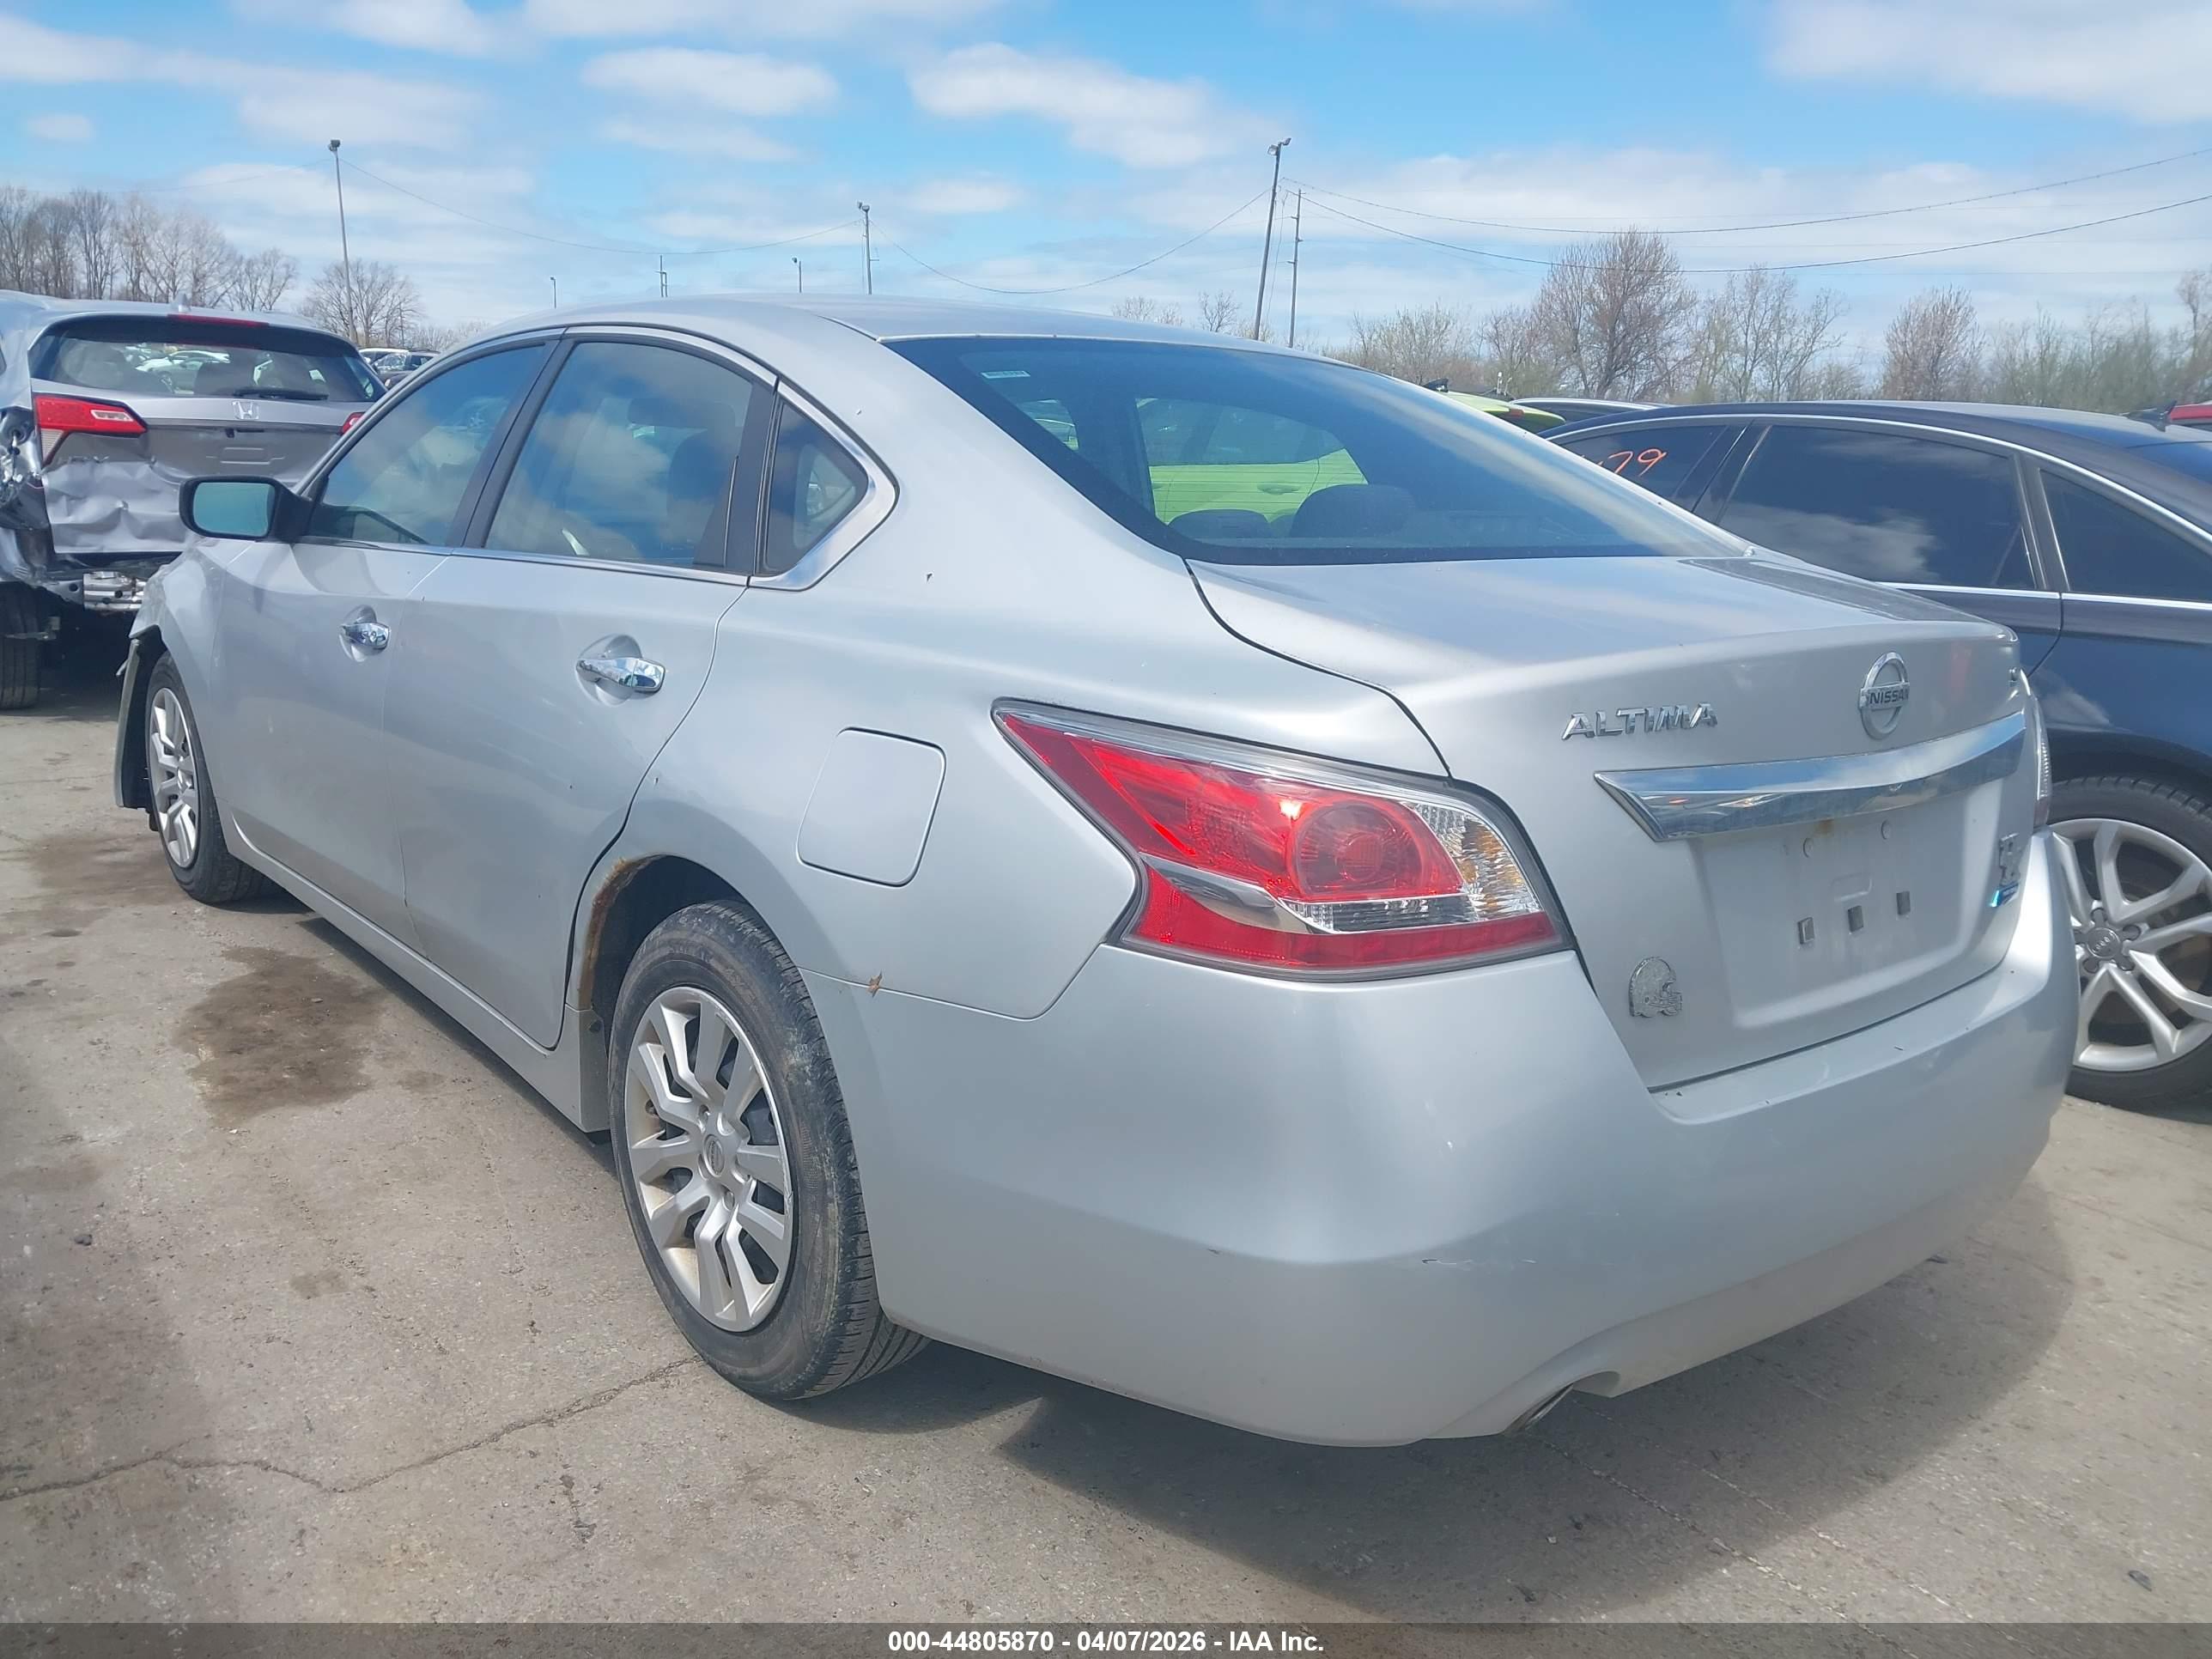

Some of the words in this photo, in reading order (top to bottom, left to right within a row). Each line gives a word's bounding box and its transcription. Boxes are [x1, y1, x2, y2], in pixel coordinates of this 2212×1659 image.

[1597, 448, 1668, 476] 79
[1869, 688, 1909, 704] NISSAN
[1561, 702, 1718, 740] ALTIMA
